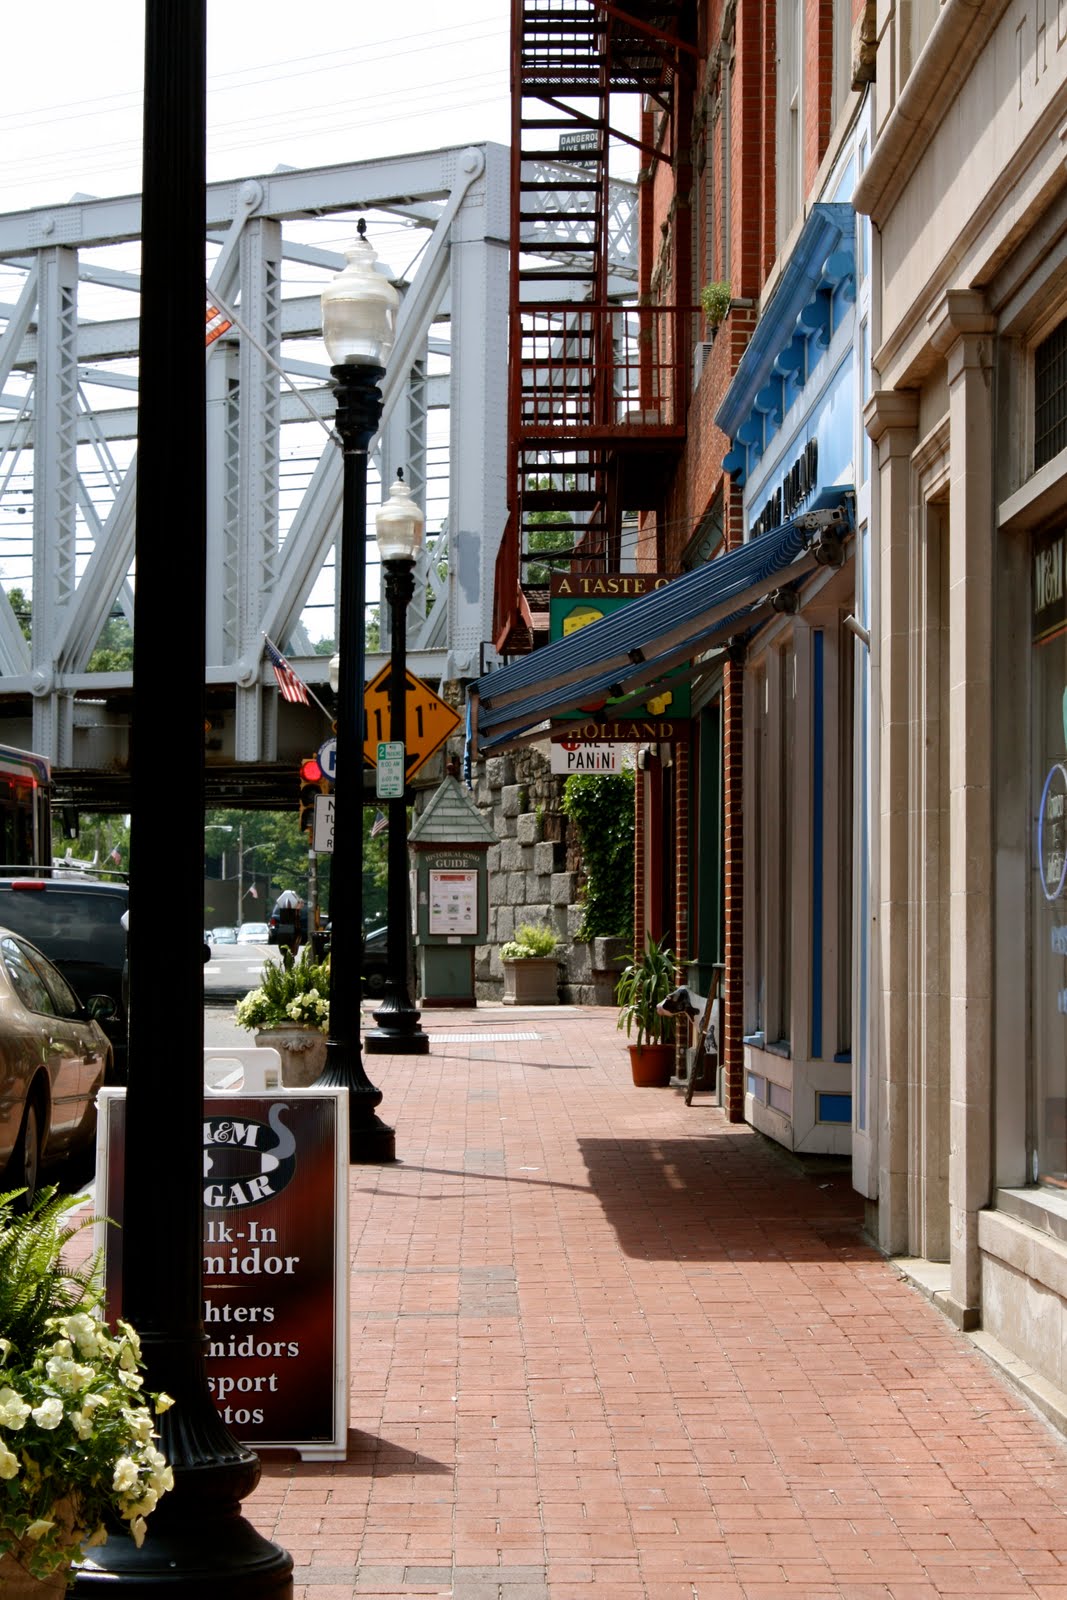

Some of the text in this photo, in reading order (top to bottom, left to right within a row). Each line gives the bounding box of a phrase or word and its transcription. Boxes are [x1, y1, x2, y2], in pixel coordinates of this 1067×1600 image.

[561, 133, 598, 145] DANGERO
[580, 142, 598, 150] WIRE
[558, 579, 572, 593] A
[580, 579, 646, 593] TASTE
[567, 723, 674, 739] HOLLAND
[379, 746, 385, 757] 2
[324, 814, 335, 824] TU
[435, 859, 470, 868] GUIDE
[203, 1175, 276, 1207] GAR
[203, 1221, 278, 1243] lk-In
[203, 1247, 300, 1275] midor
[203, 1299, 275, 1323] hters
[203, 1334, 300, 1357] midors
[206, 1373, 279, 1400] sport
[217, 1405, 264, 1425] tos
